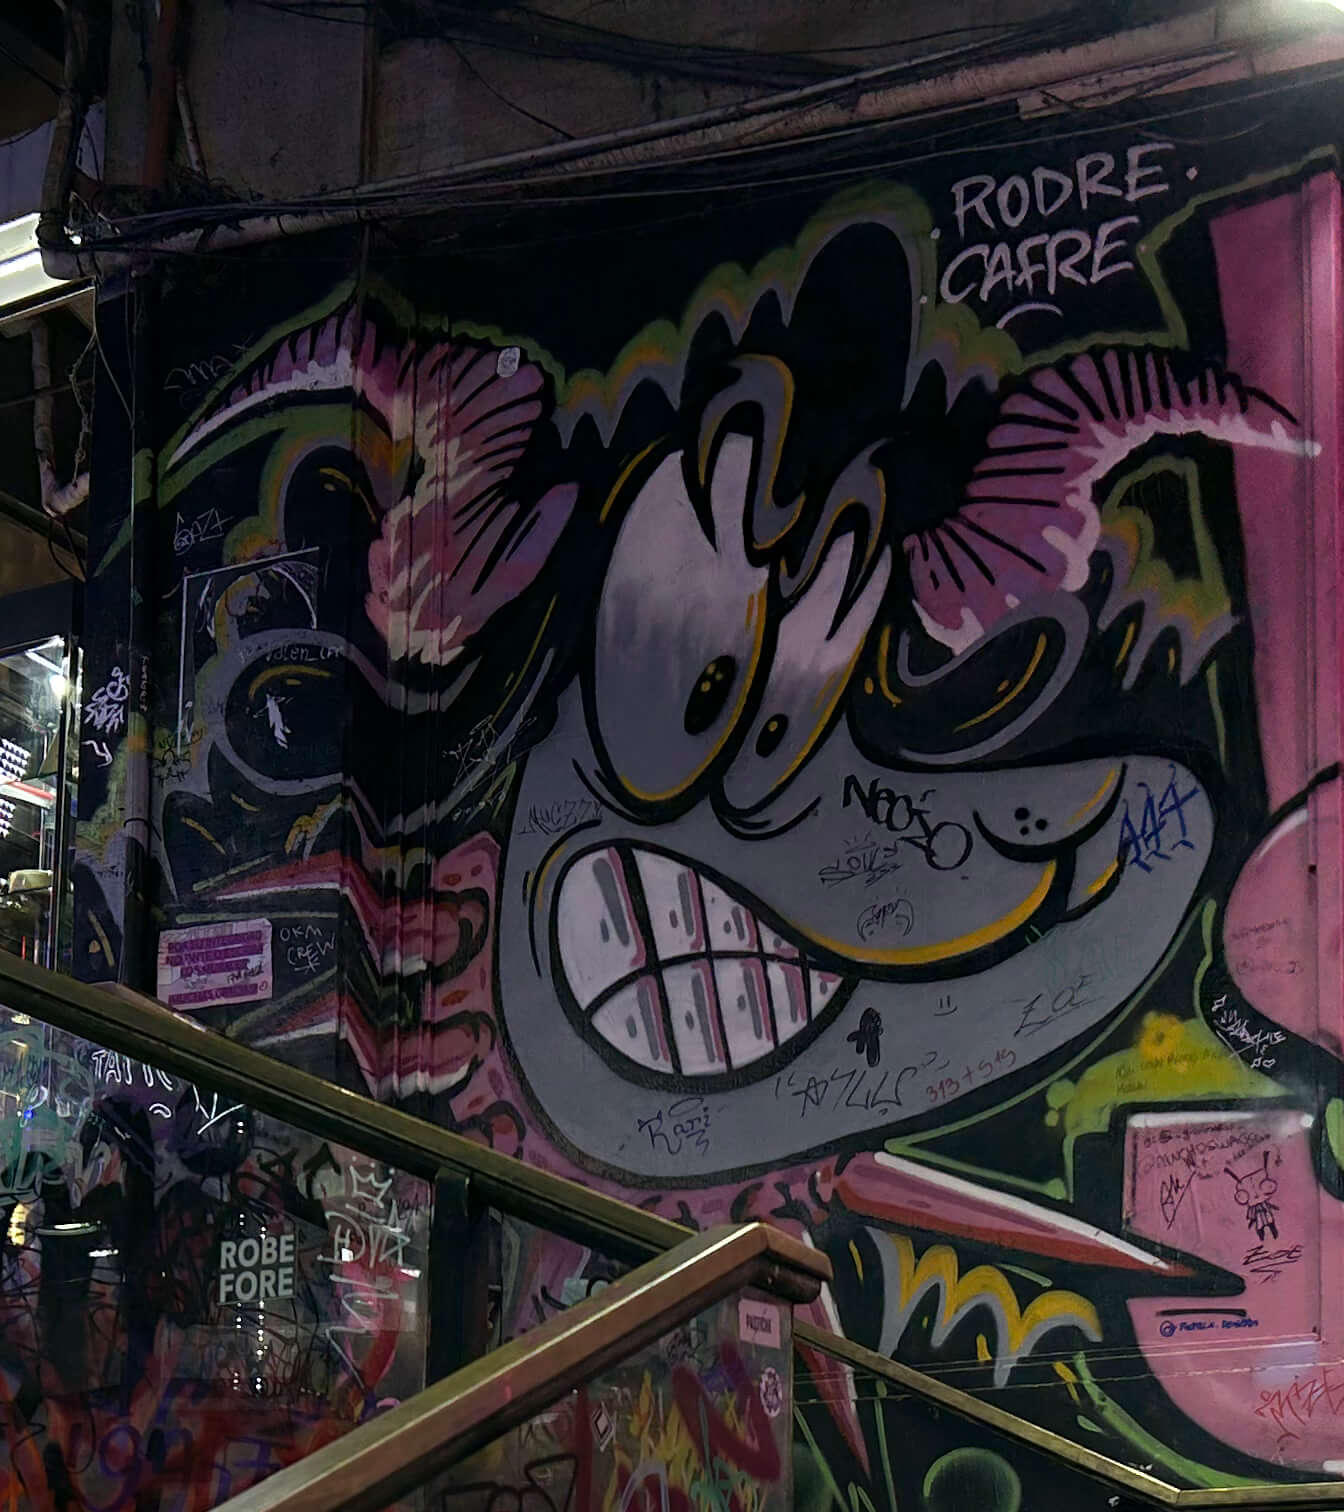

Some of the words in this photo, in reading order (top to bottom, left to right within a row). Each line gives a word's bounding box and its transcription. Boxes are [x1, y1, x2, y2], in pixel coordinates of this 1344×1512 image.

[951, 143, 1176, 241] RODRE
[938, 215, 1141, 303] CAFRE
[220, 1235, 295, 1269] ROBE
[219, 1267, 294, 1303] FORE
